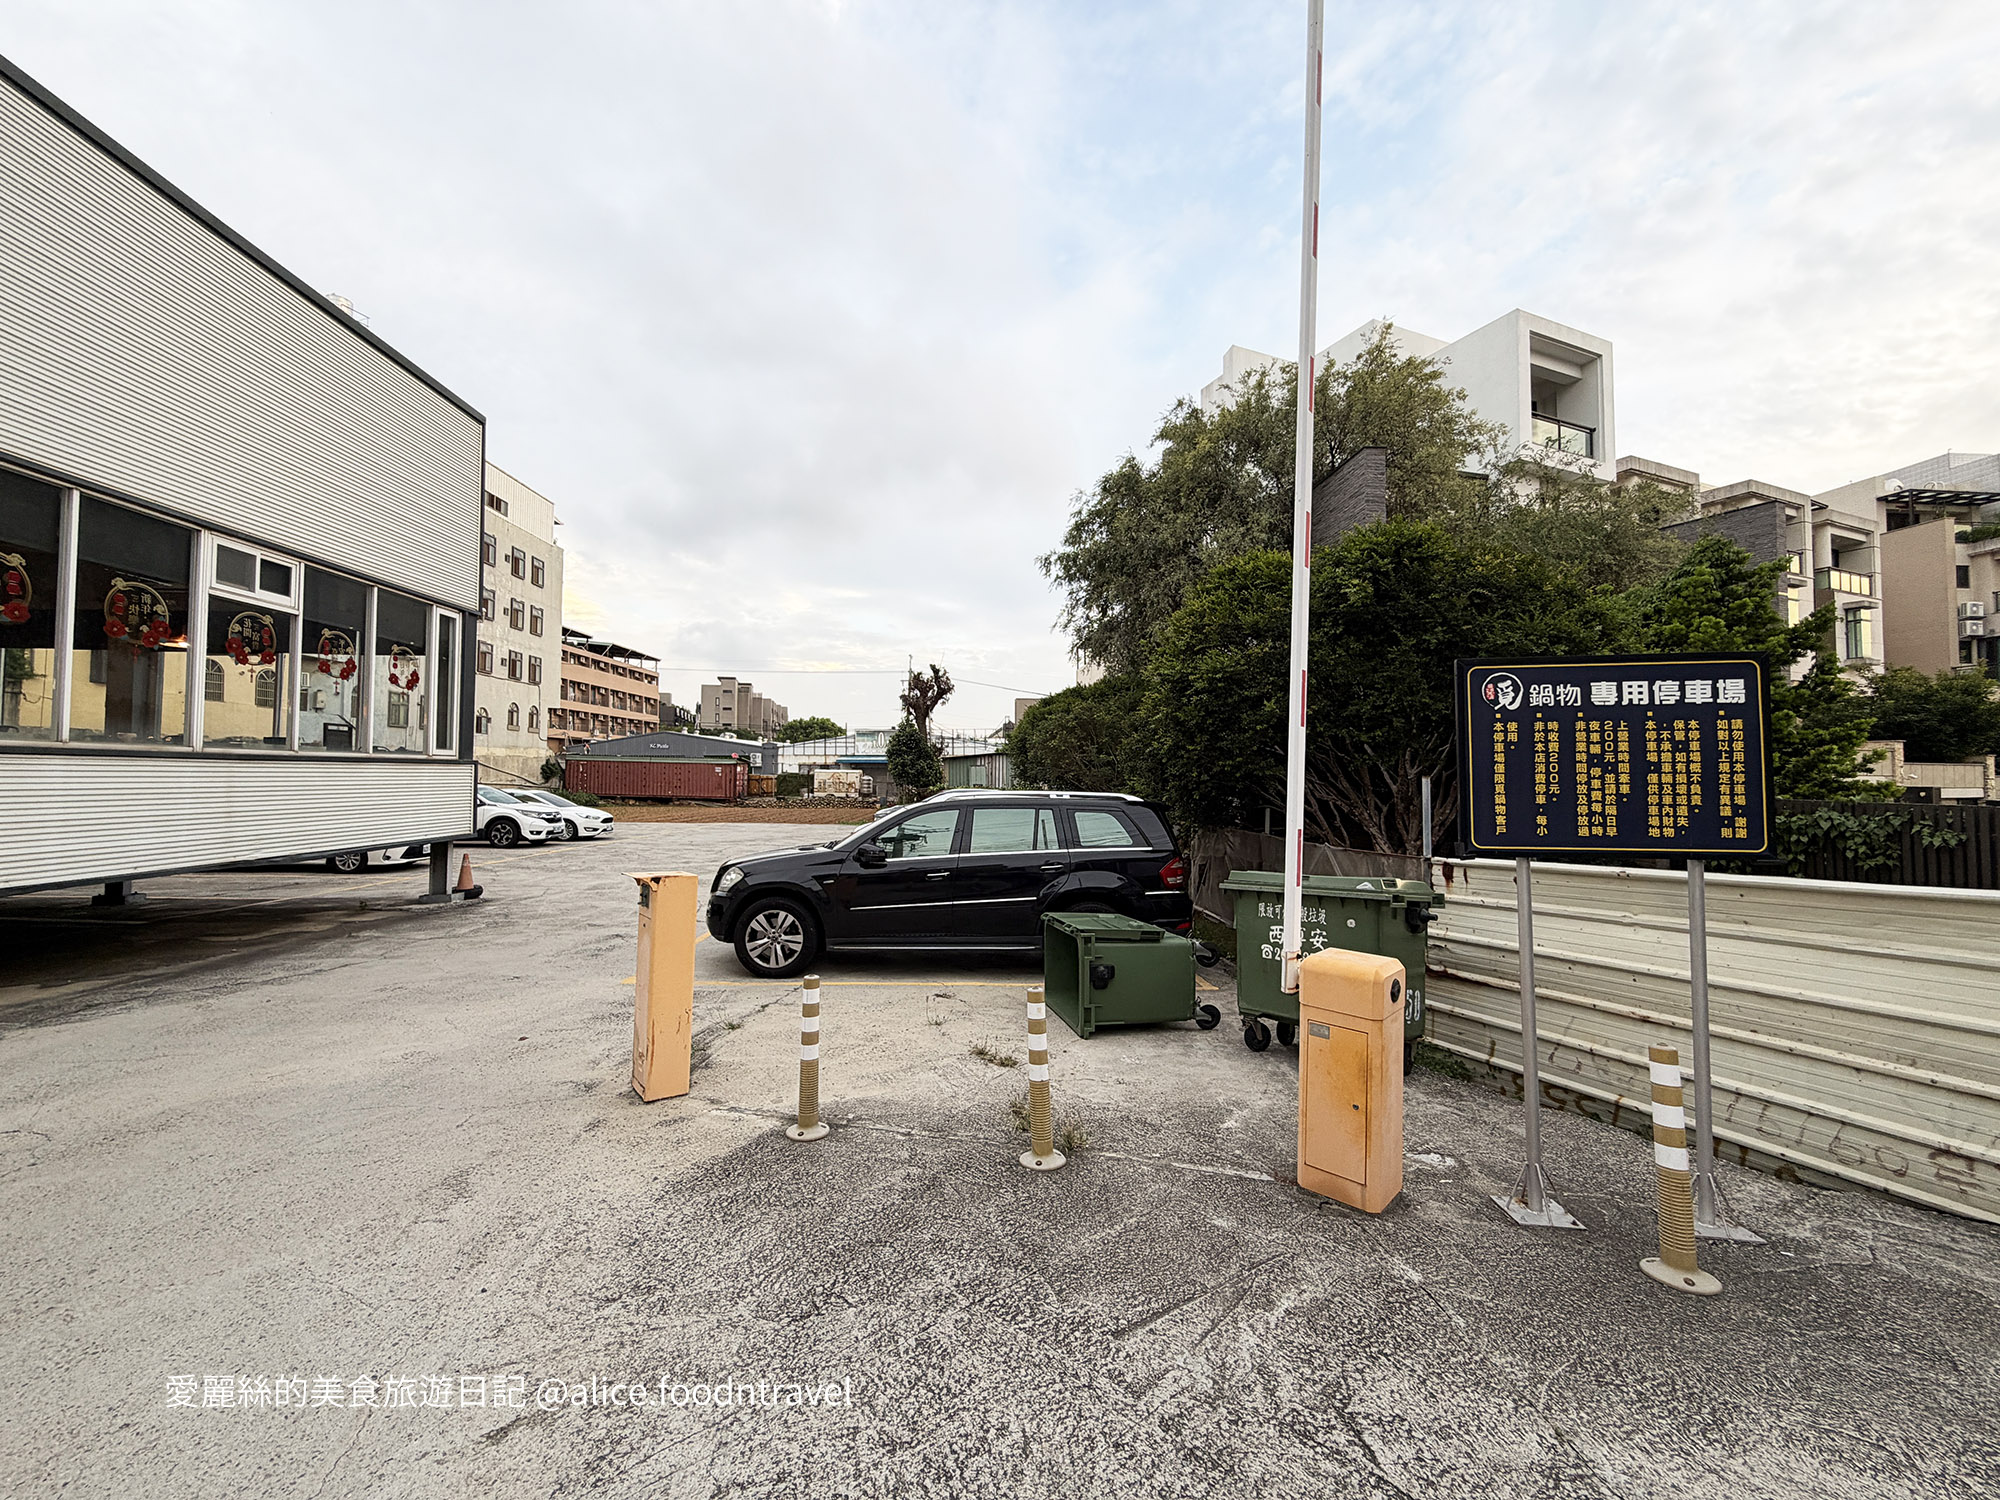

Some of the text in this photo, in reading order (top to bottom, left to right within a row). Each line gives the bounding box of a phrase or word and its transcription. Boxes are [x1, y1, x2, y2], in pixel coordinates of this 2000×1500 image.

[1529, 683, 1581, 707] 鍋物
[1590, 679, 1746, 706] 專用停車場
[1269, 925, 1328, 950] 西安
